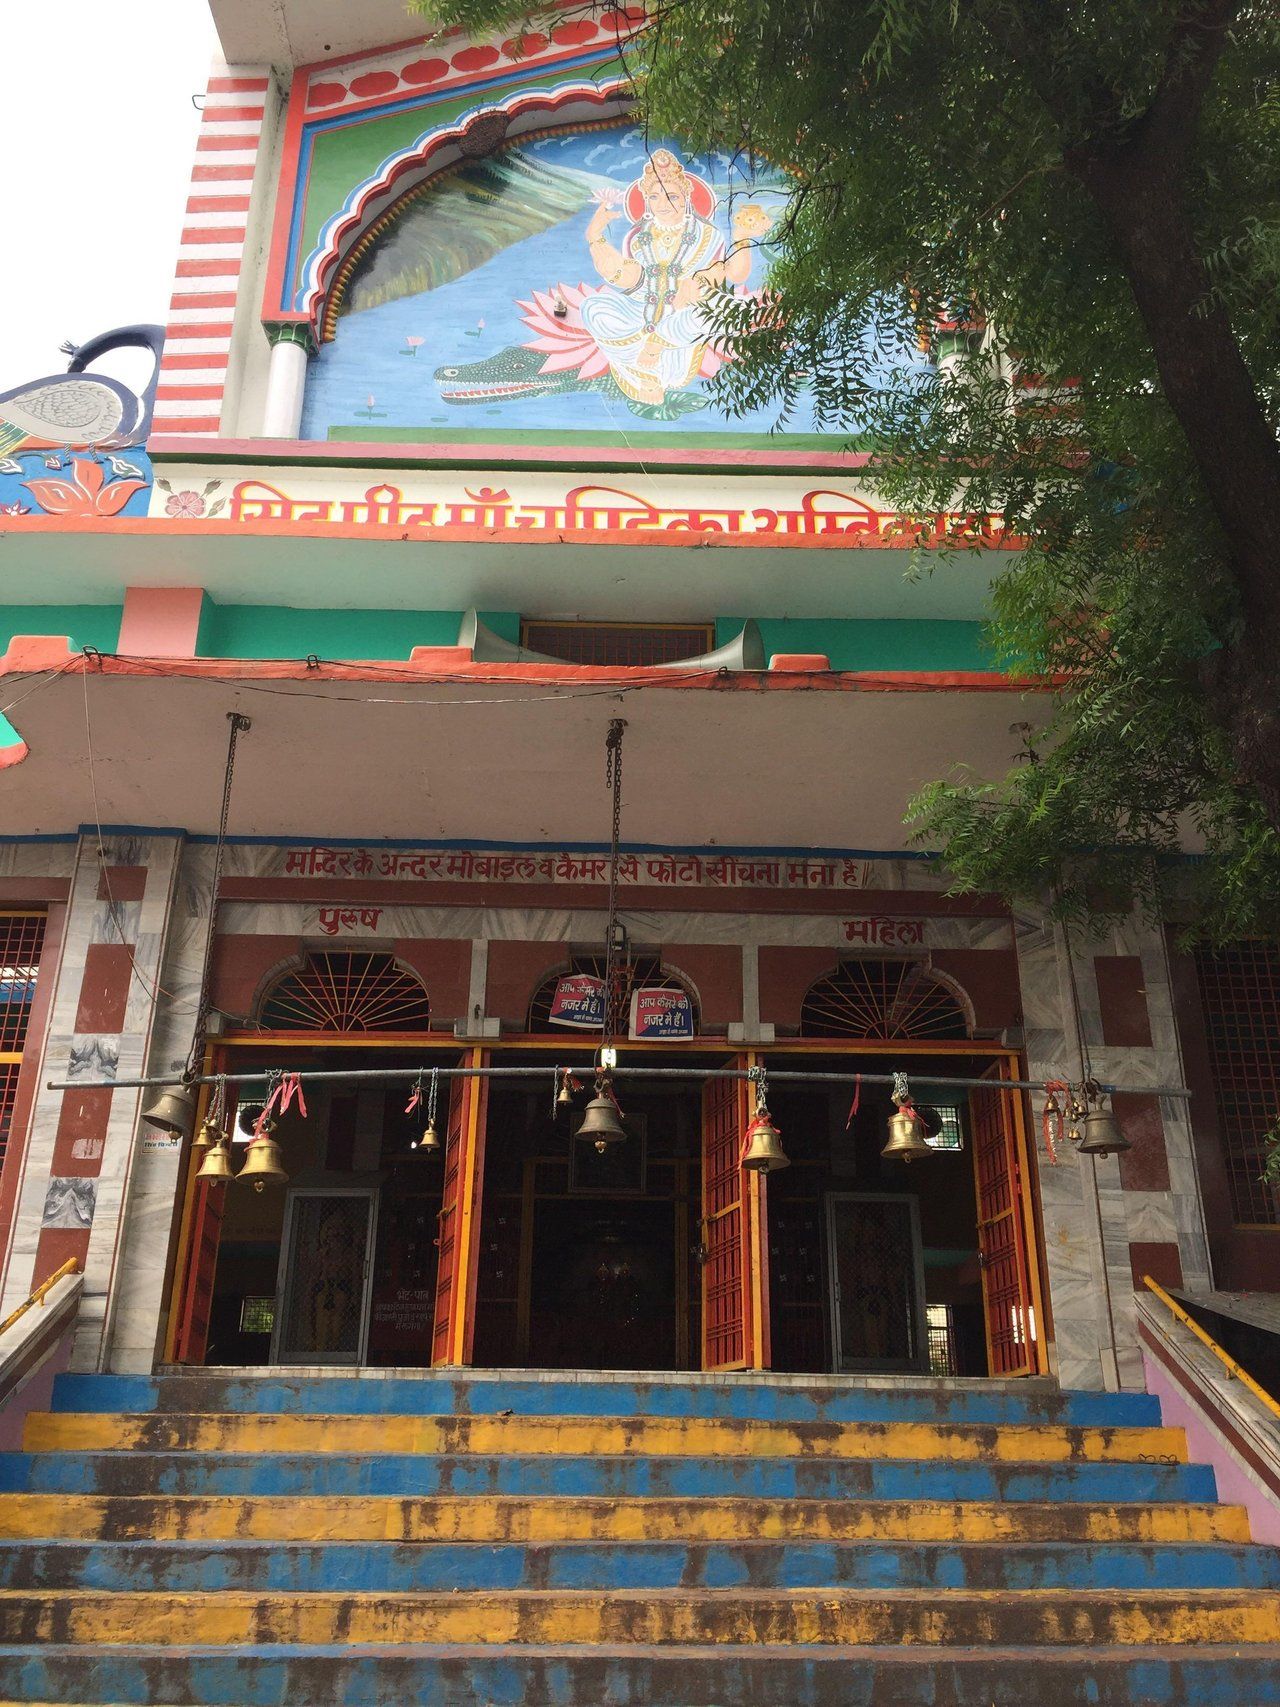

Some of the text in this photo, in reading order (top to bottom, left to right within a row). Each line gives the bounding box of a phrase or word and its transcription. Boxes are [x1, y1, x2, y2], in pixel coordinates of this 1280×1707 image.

[353, 848, 374, 875] के
[377, 853, 444, 879] अन्दर
[447, 851, 536, 881] मोबाइल
[619, 854, 641, 883] से
[646, 854, 702, 884] फोटो
[786, 862, 838, 886] मना
[842, 916, 924, 946] महिला
[640, 997, 656, 1009] आप
